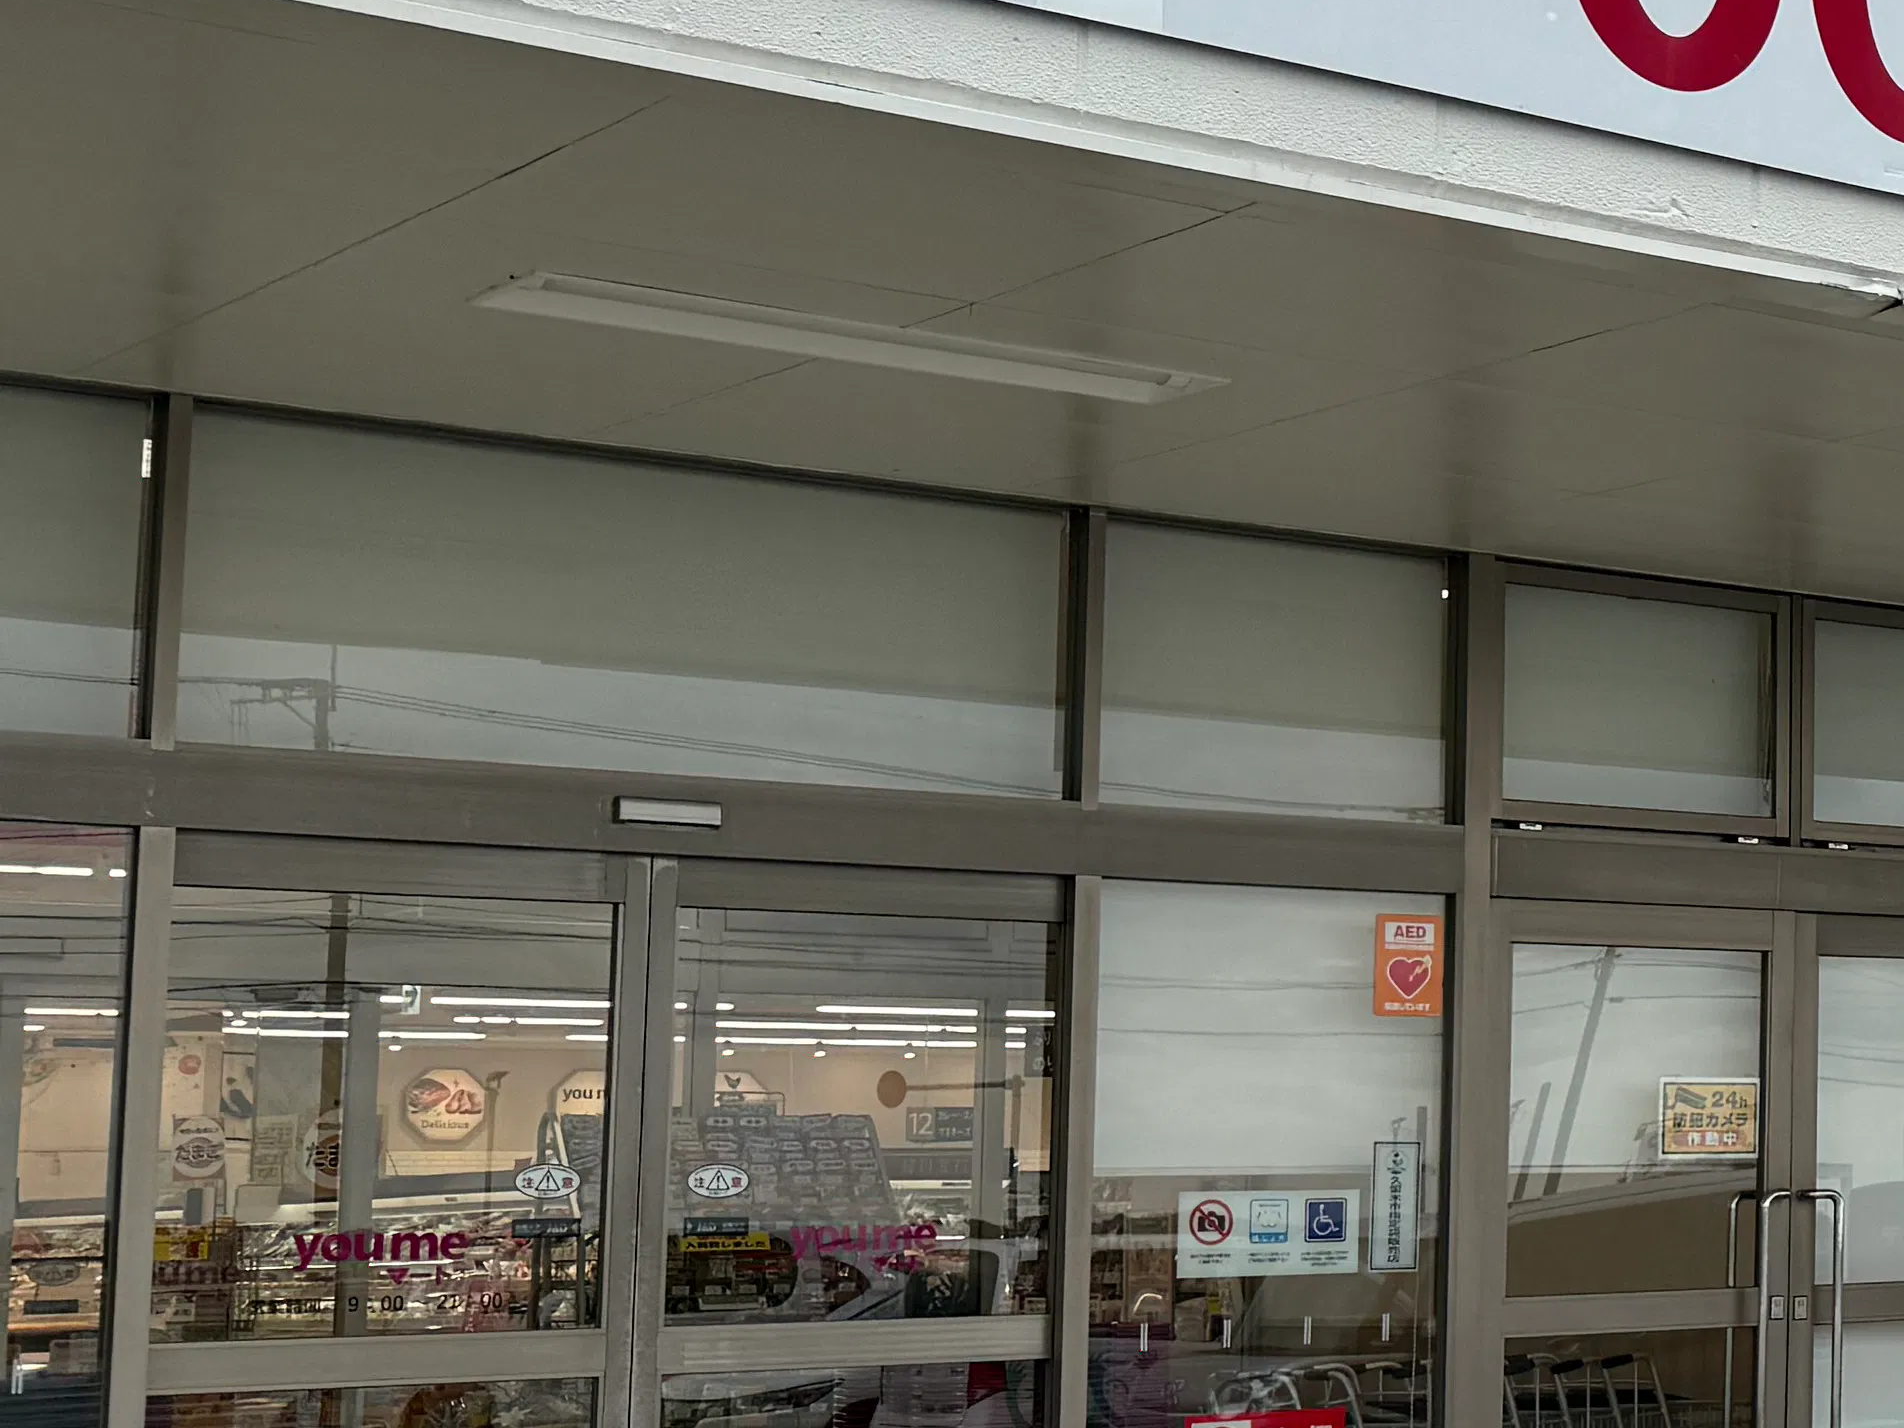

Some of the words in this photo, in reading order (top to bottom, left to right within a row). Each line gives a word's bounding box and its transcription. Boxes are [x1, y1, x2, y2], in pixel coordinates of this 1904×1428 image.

[1393, 924, 1427, 939] AED
[1711, 1090, 1747, 1109] 24h
[908, 1112, 933, 1136] 12
[1673, 1112, 1749, 1129] 防犯カメラ
[291, 1229, 470, 1272] youme
[789, 1222, 938, 1261] youme
